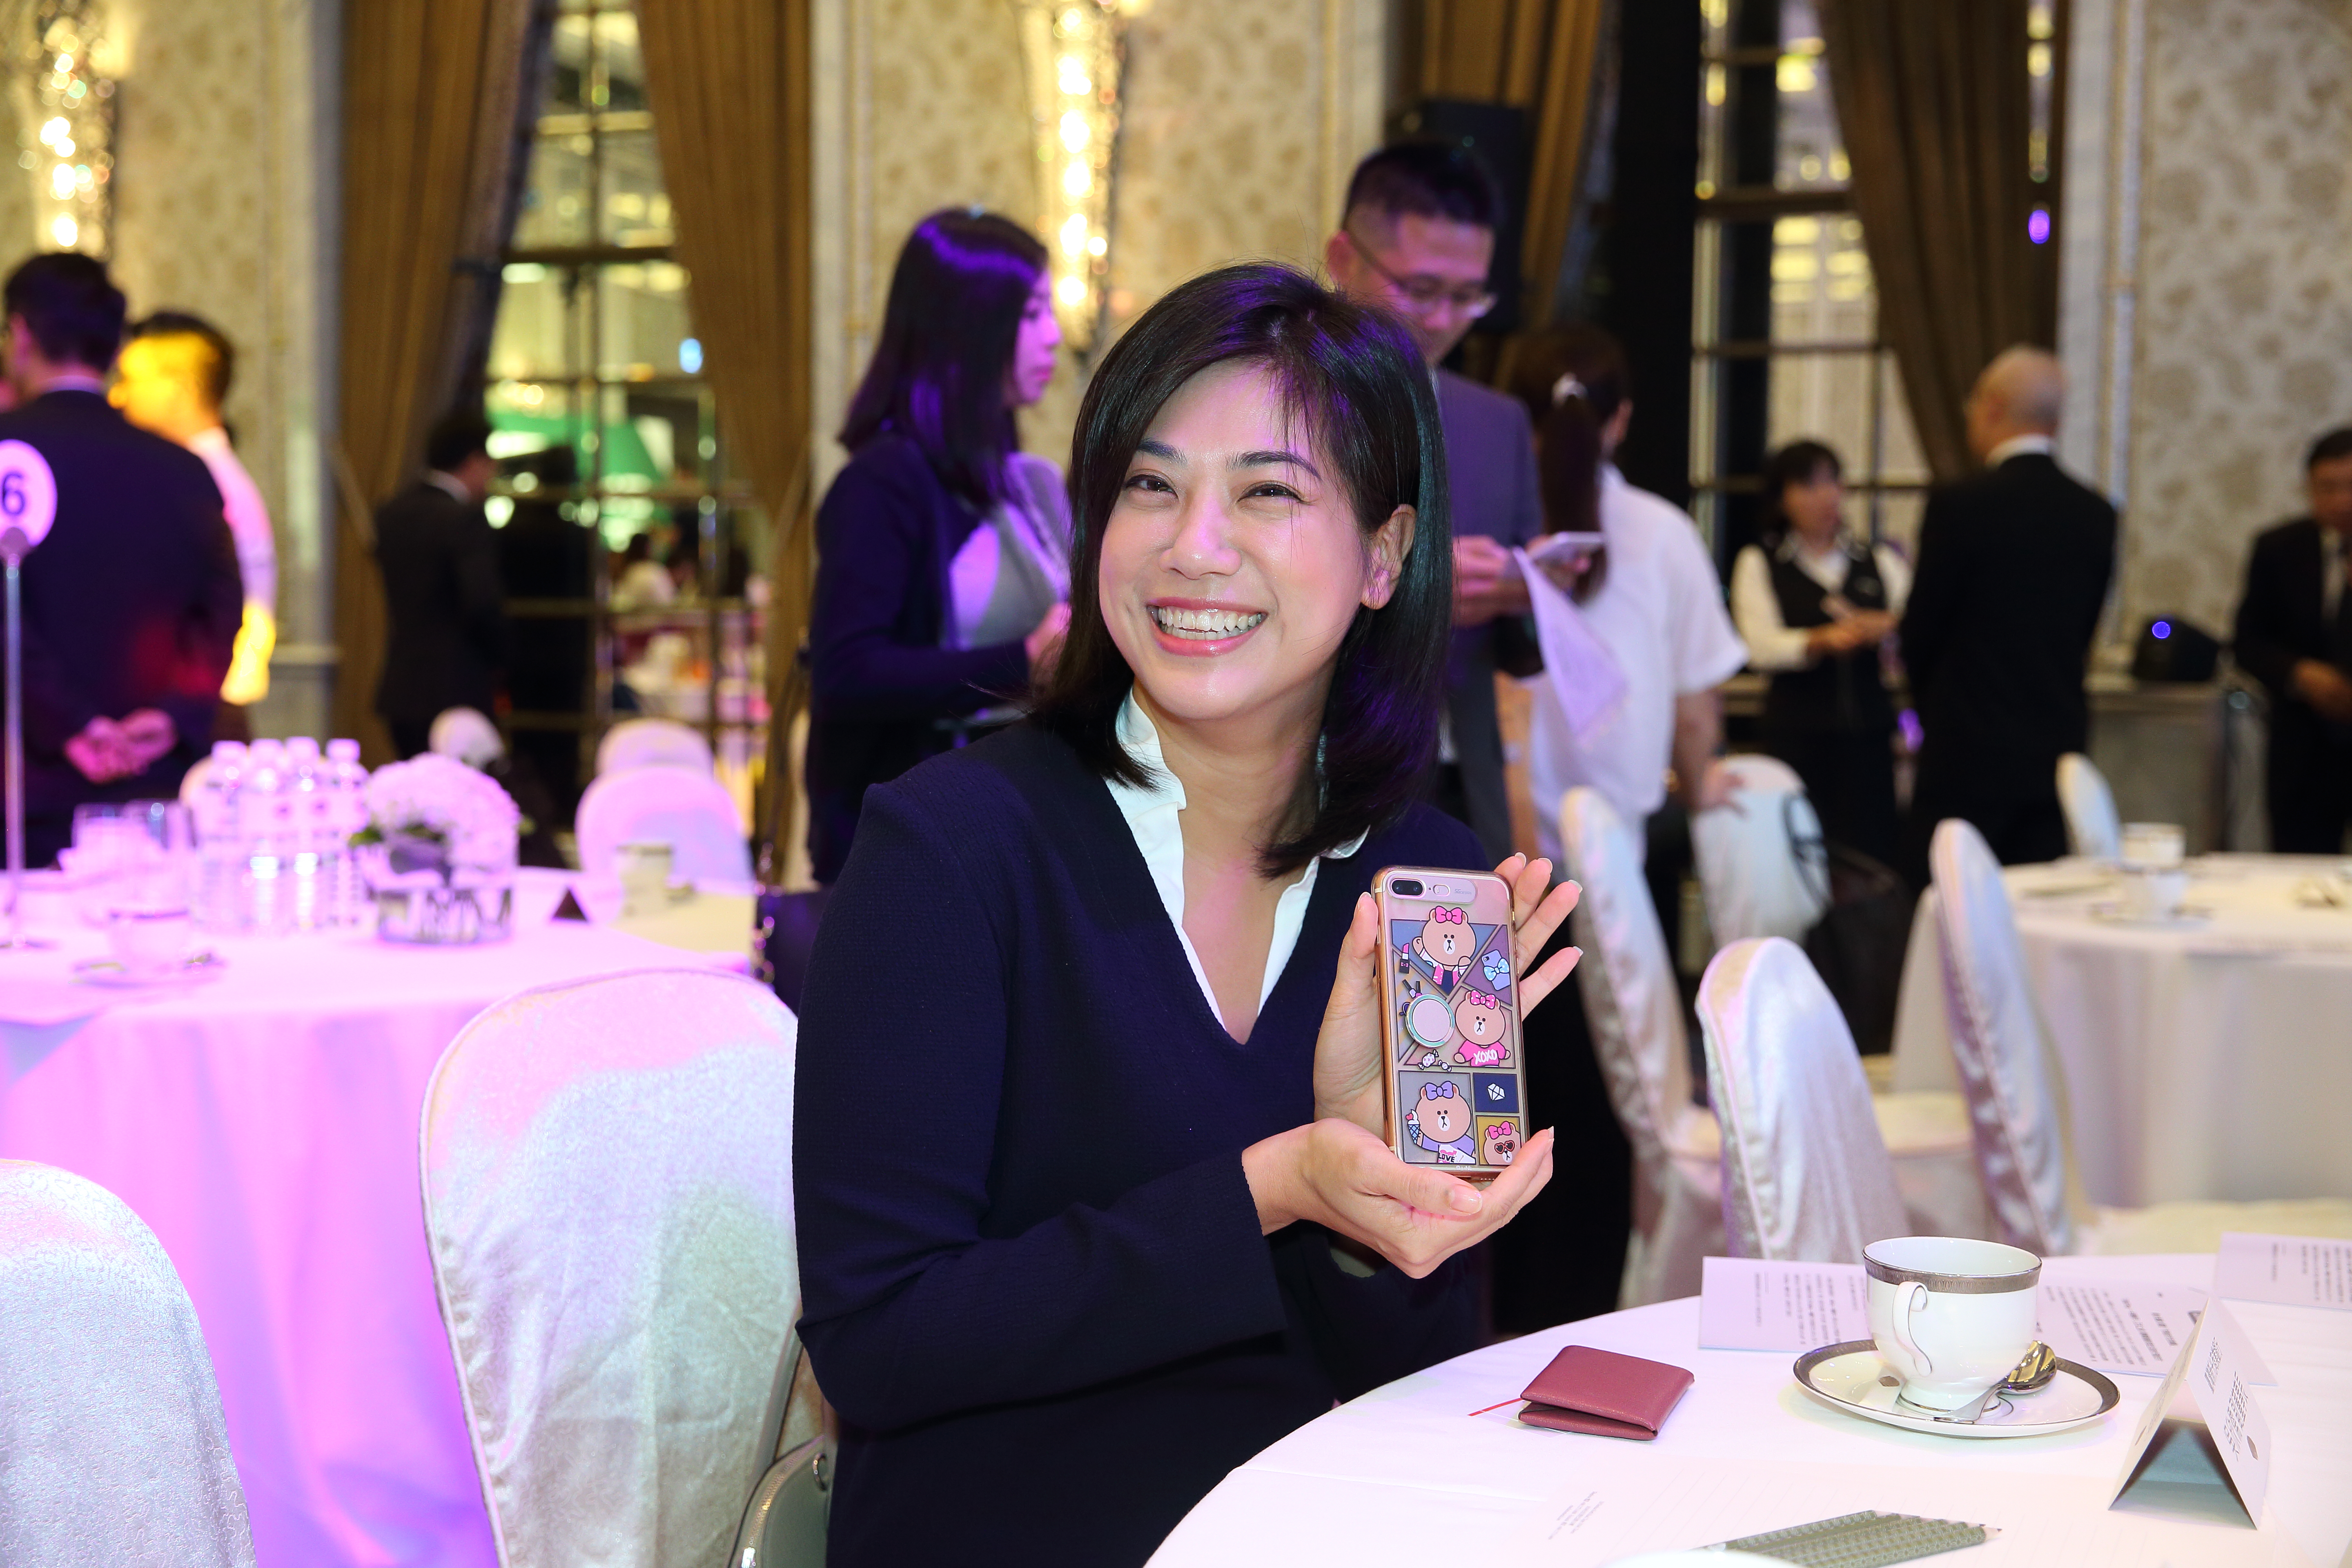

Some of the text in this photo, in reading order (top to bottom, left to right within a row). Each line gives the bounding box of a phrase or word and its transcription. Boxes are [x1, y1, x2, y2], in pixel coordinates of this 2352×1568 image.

[2, 472, 25, 515] 6
[1473, 1049, 1497, 1065] XOXO
[1439, 1152, 1455, 1163] LOVE
